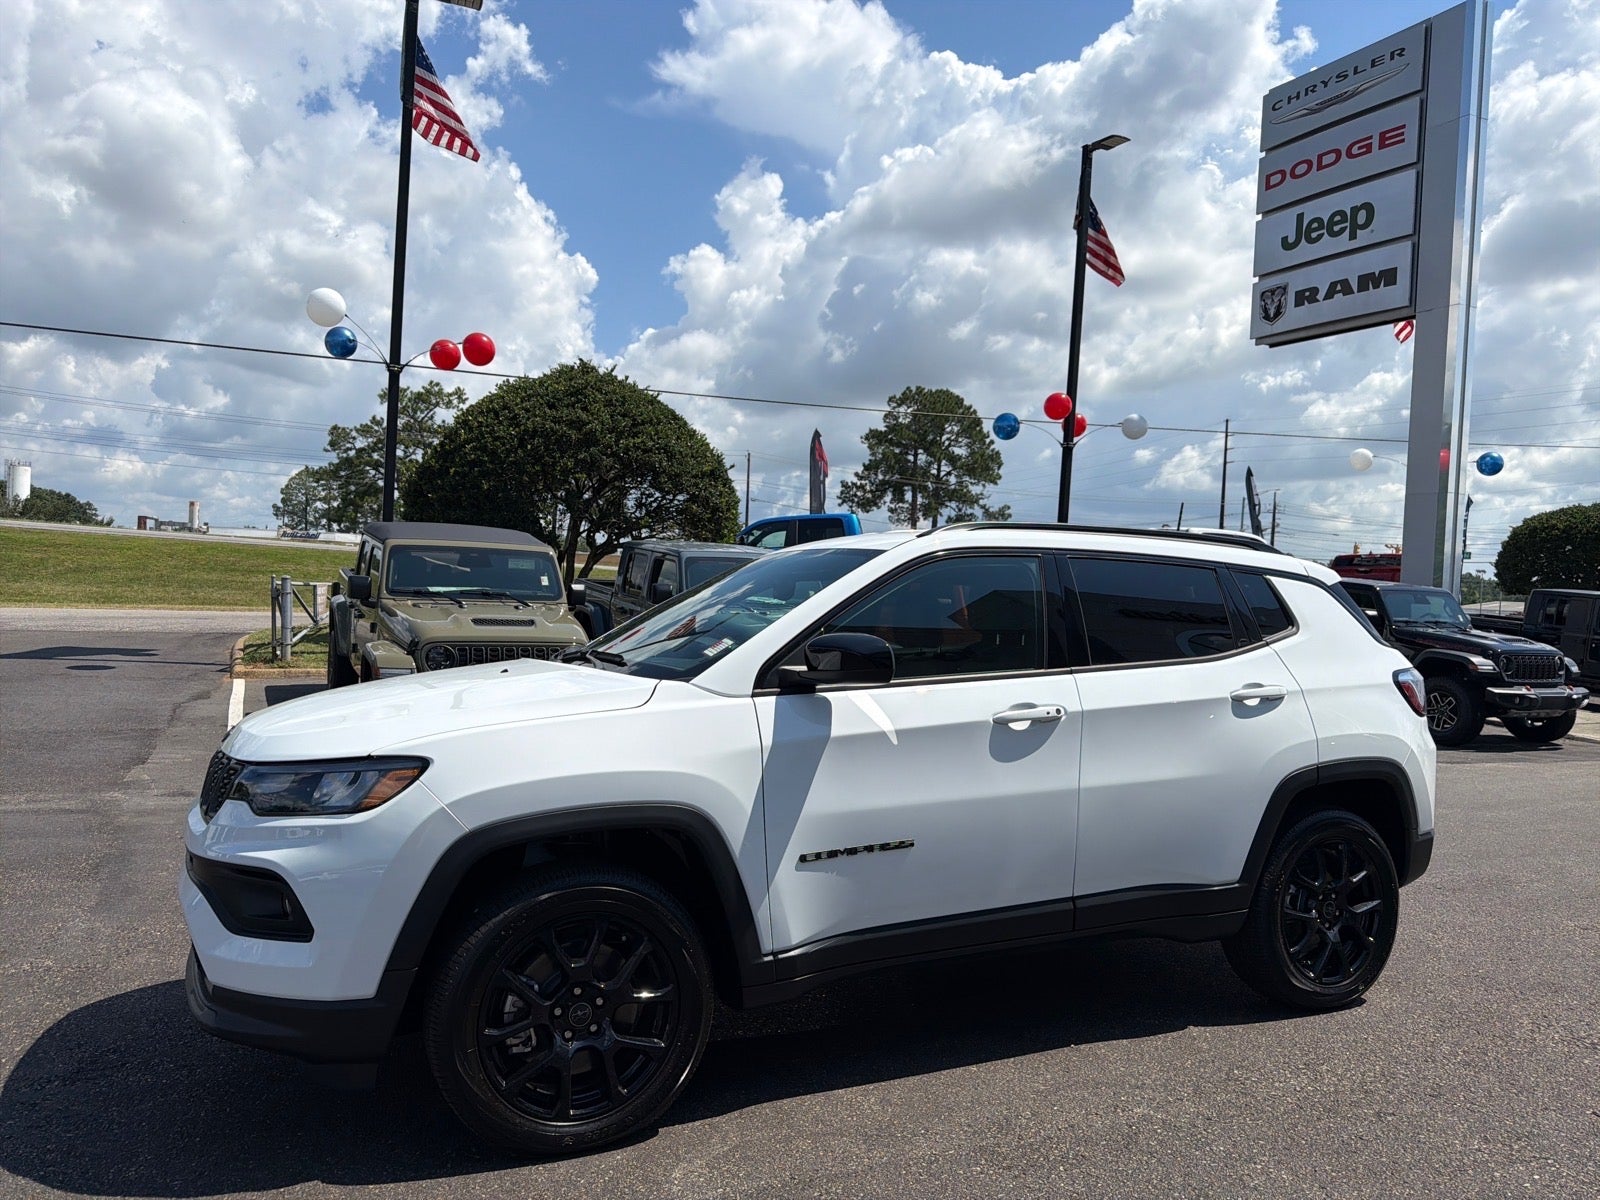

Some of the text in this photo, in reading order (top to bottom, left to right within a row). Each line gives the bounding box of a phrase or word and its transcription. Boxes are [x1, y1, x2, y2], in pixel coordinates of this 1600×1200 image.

[1271, 47, 1406, 112] CHRYSLER
[1264, 124, 1407, 191] DODGE
[1280, 201, 1376, 251] Jeep
[1294, 267, 1398, 308] RAM
